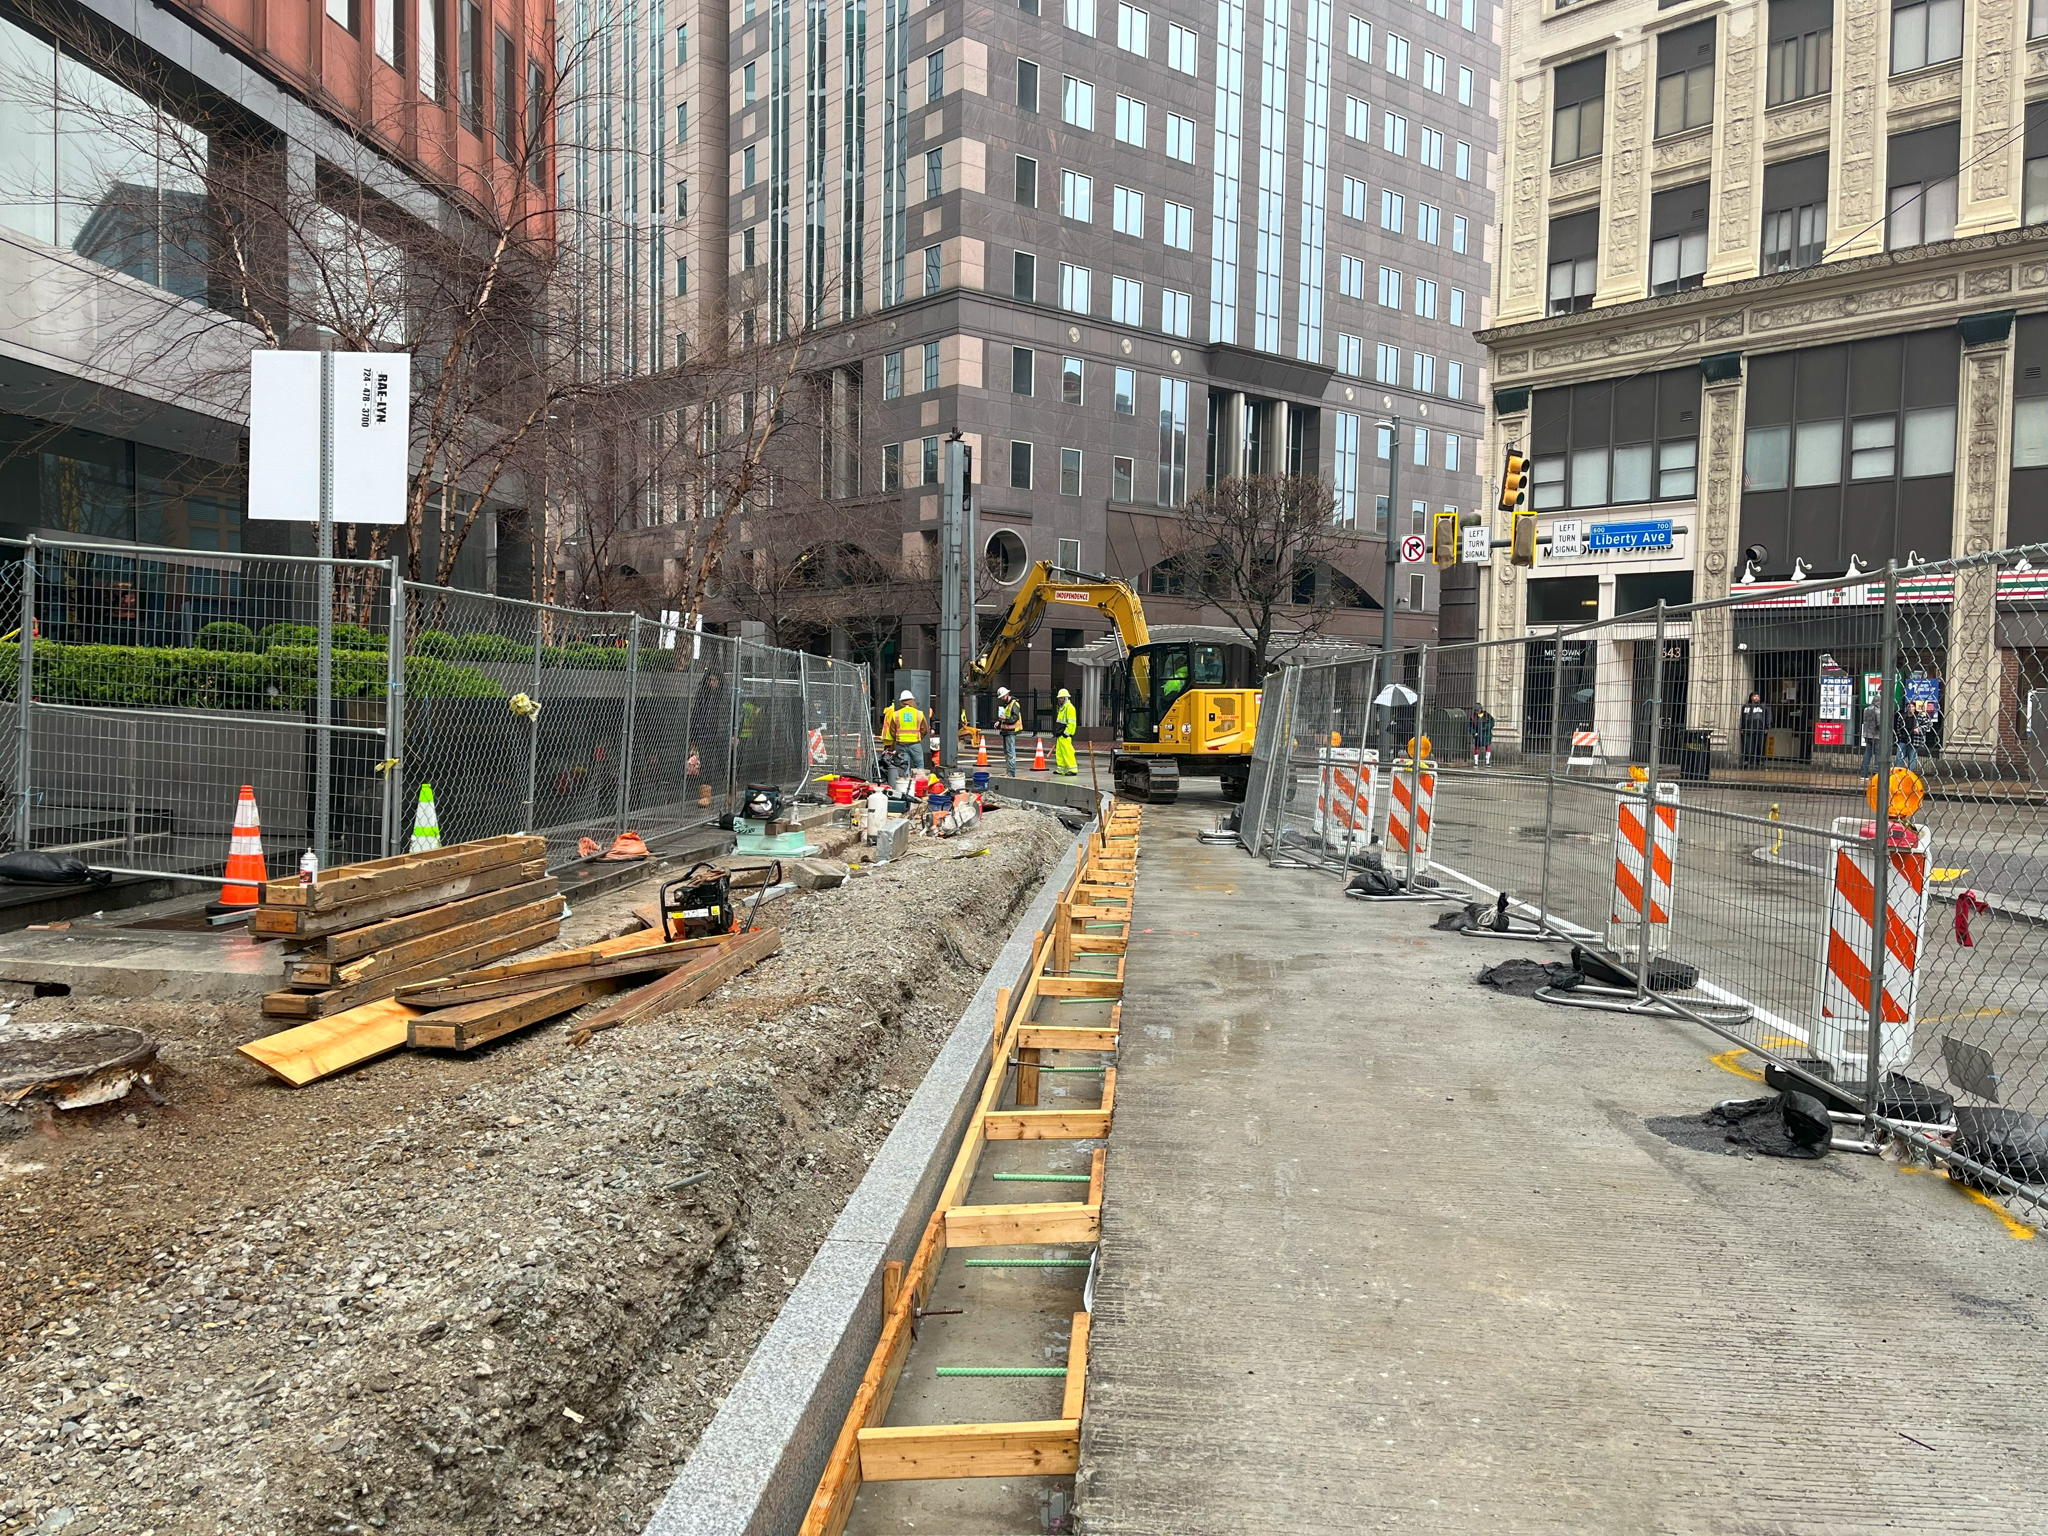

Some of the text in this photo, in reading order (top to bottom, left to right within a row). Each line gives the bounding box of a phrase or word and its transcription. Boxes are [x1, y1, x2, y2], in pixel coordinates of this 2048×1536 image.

[363, 368, 371, 382] 724
[362, 388, 370, 402] 478
[376, 374, 388, 423] RAE-LYN
[361, 408, 370, 428] 3700
[1559, 523, 1575, 532] LEFT
[1469, 529, 1484, 538] LEFT
[1559, 534, 1576, 542] TURN
[1595, 532, 1665, 546] Liberty Ave
[1469, 540, 1484, 548] TURN
[1465, 550, 1486, 558] SIGNAL
[1555, 545, 1578, 554] SIGNAL
[1056, 592, 1088, 600] INDEPENDENCE
[1544, 649, 1580, 657] MIDOWN
